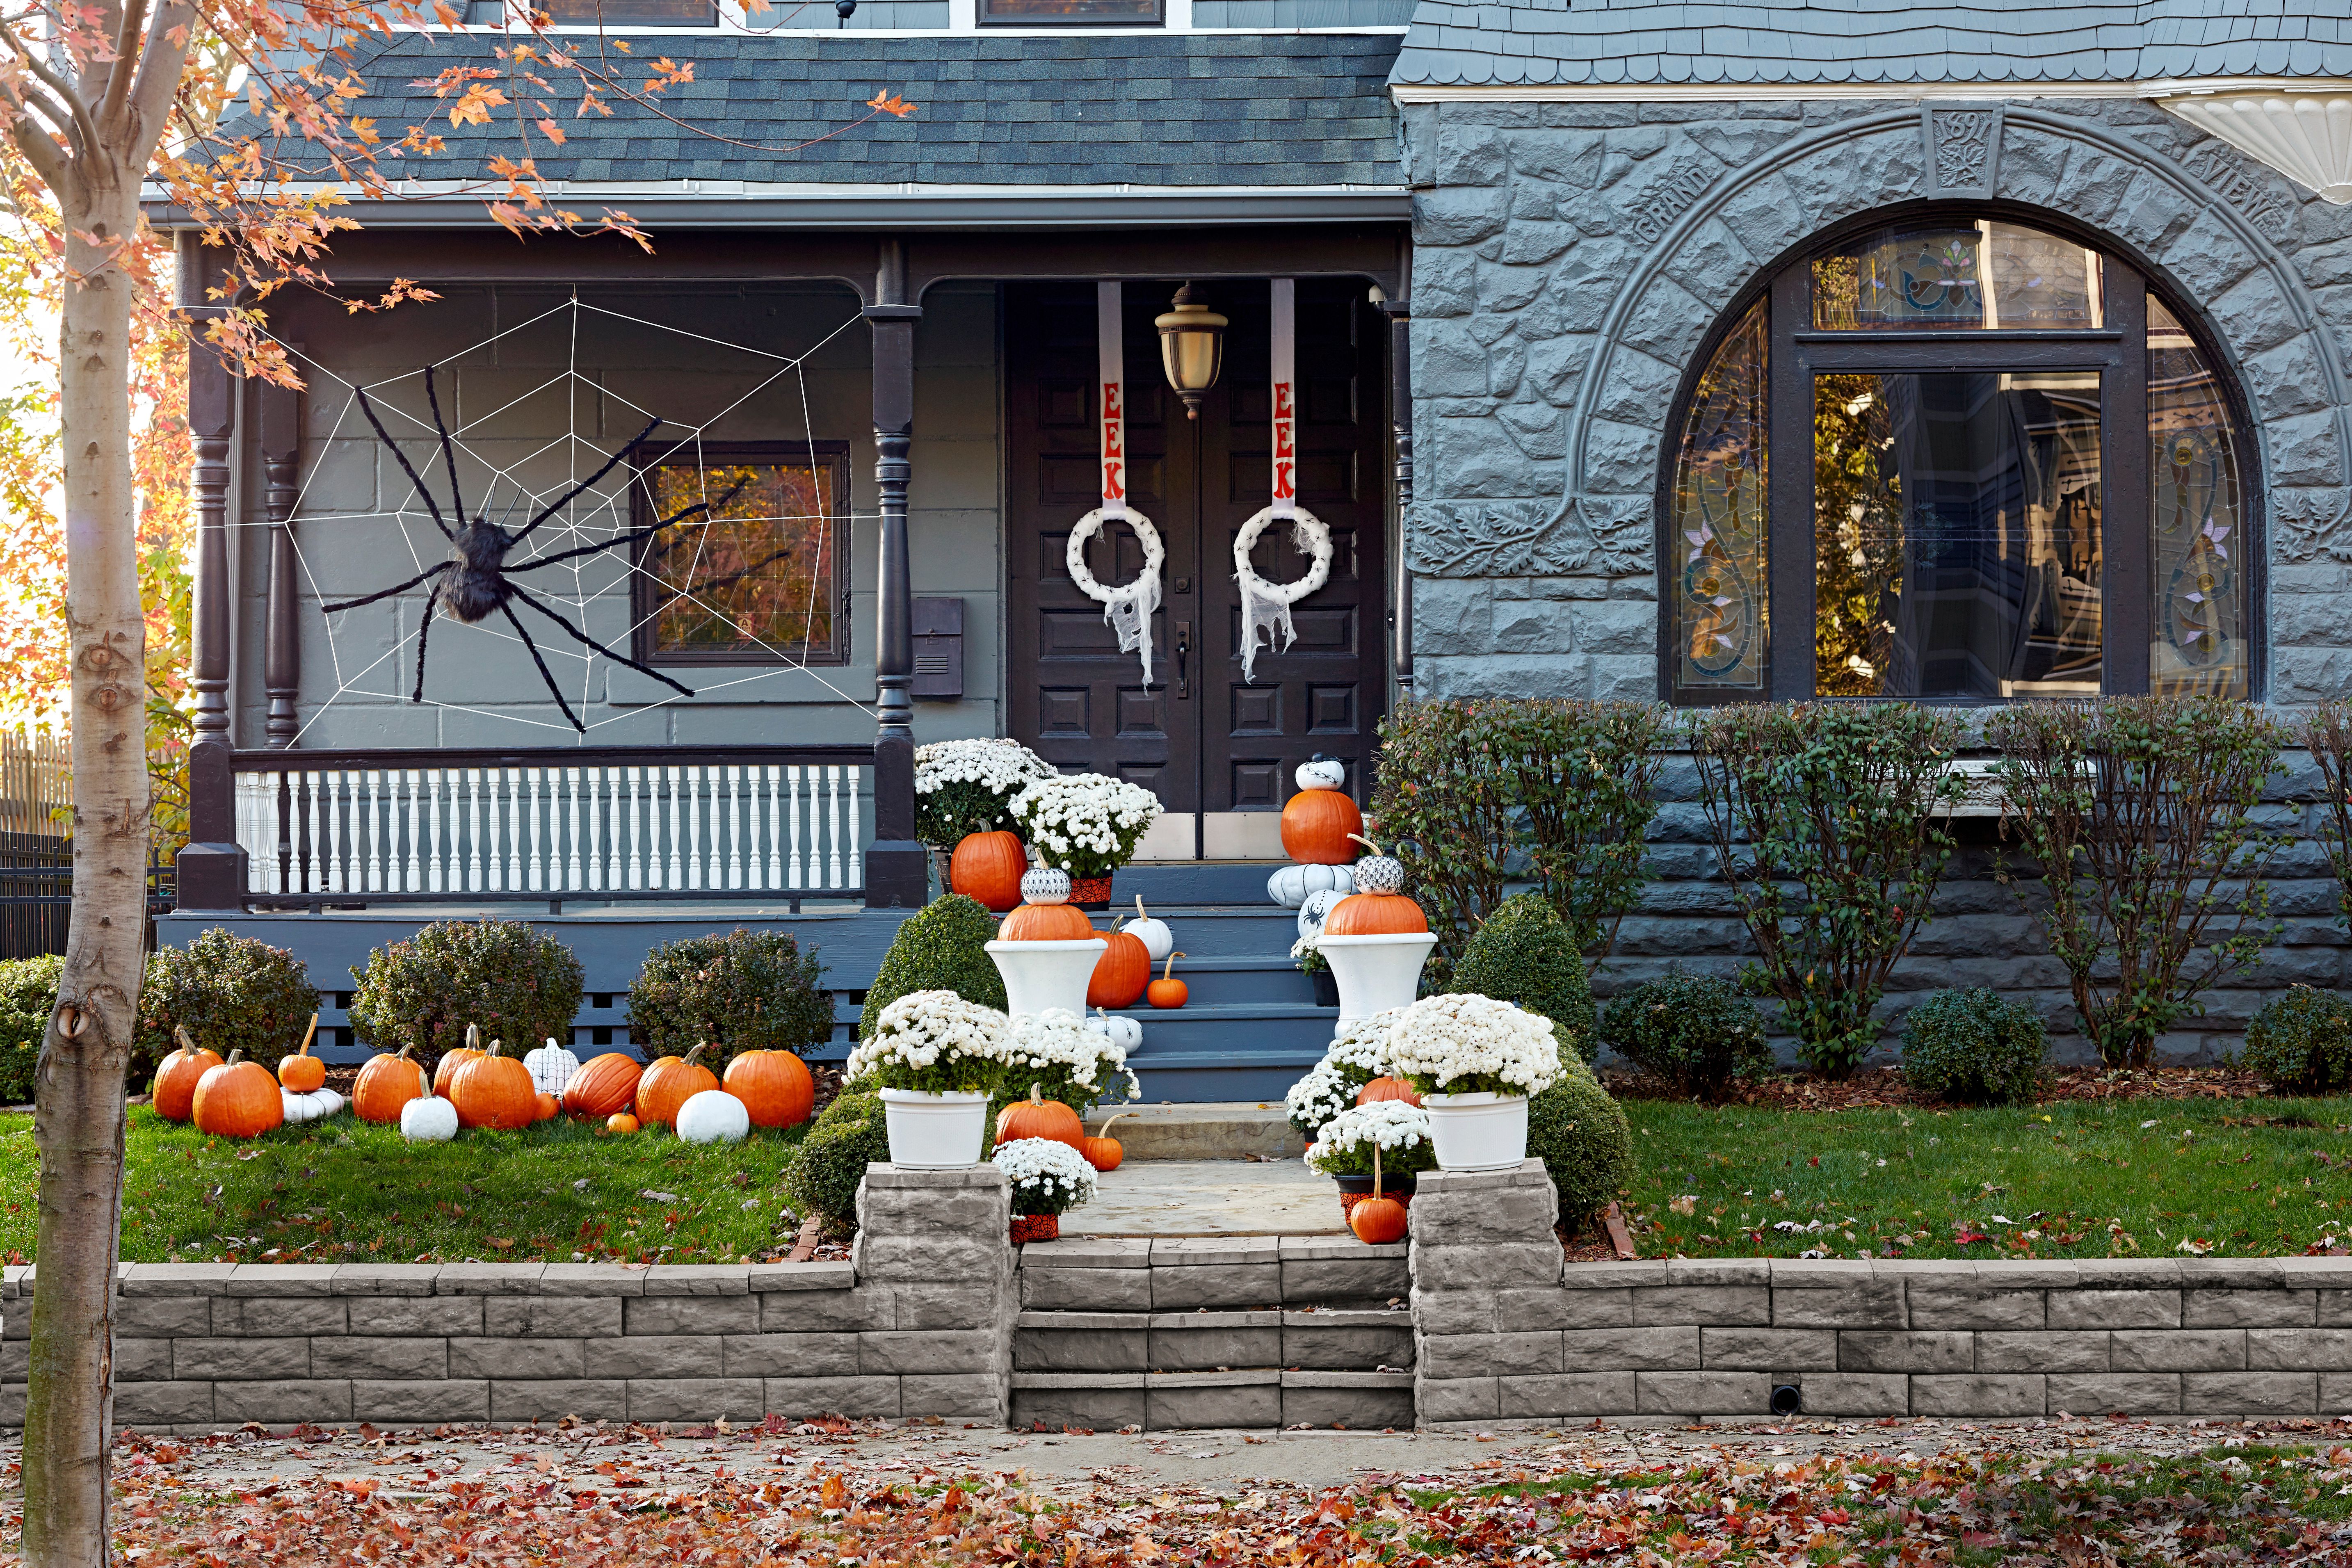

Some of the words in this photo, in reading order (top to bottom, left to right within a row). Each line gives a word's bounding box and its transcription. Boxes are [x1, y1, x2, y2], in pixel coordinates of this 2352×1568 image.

[1933, 112, 1992, 144] 1891
[1635, 167, 1711, 242] GRAND
[2200, 153, 2273, 222] VIEW
[1103, 382, 1124, 499] EEK
[1274, 382, 1294, 499] EEK
